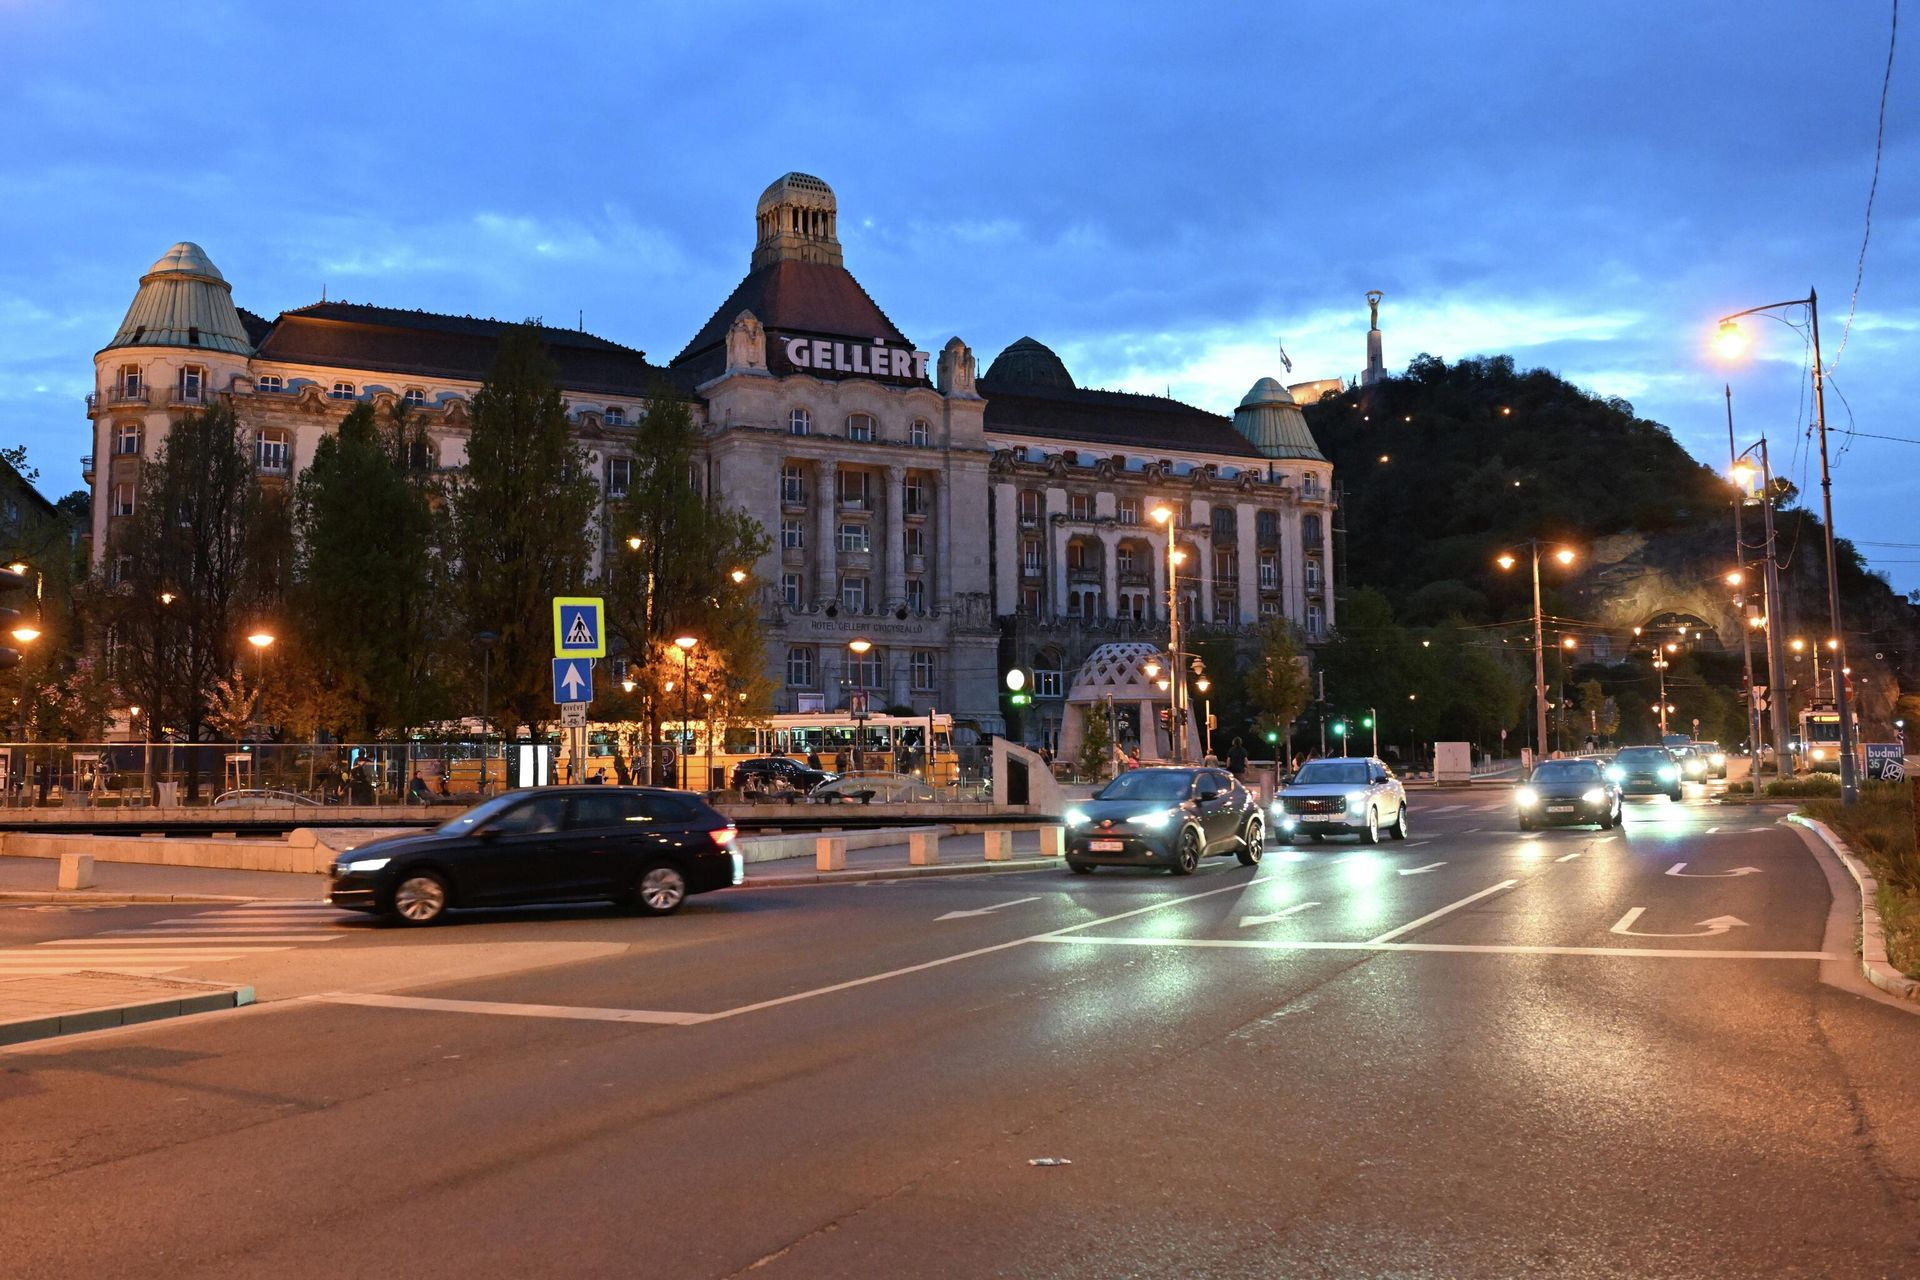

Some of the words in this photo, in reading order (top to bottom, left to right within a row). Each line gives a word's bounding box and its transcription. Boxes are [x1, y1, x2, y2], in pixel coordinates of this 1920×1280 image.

[786, 337, 930, 379] GELLÉRT
[811, 620, 835, 631] HOTEL
[1868, 746, 1902, 758] budmil
[1869, 758, 1880, 769] 35
